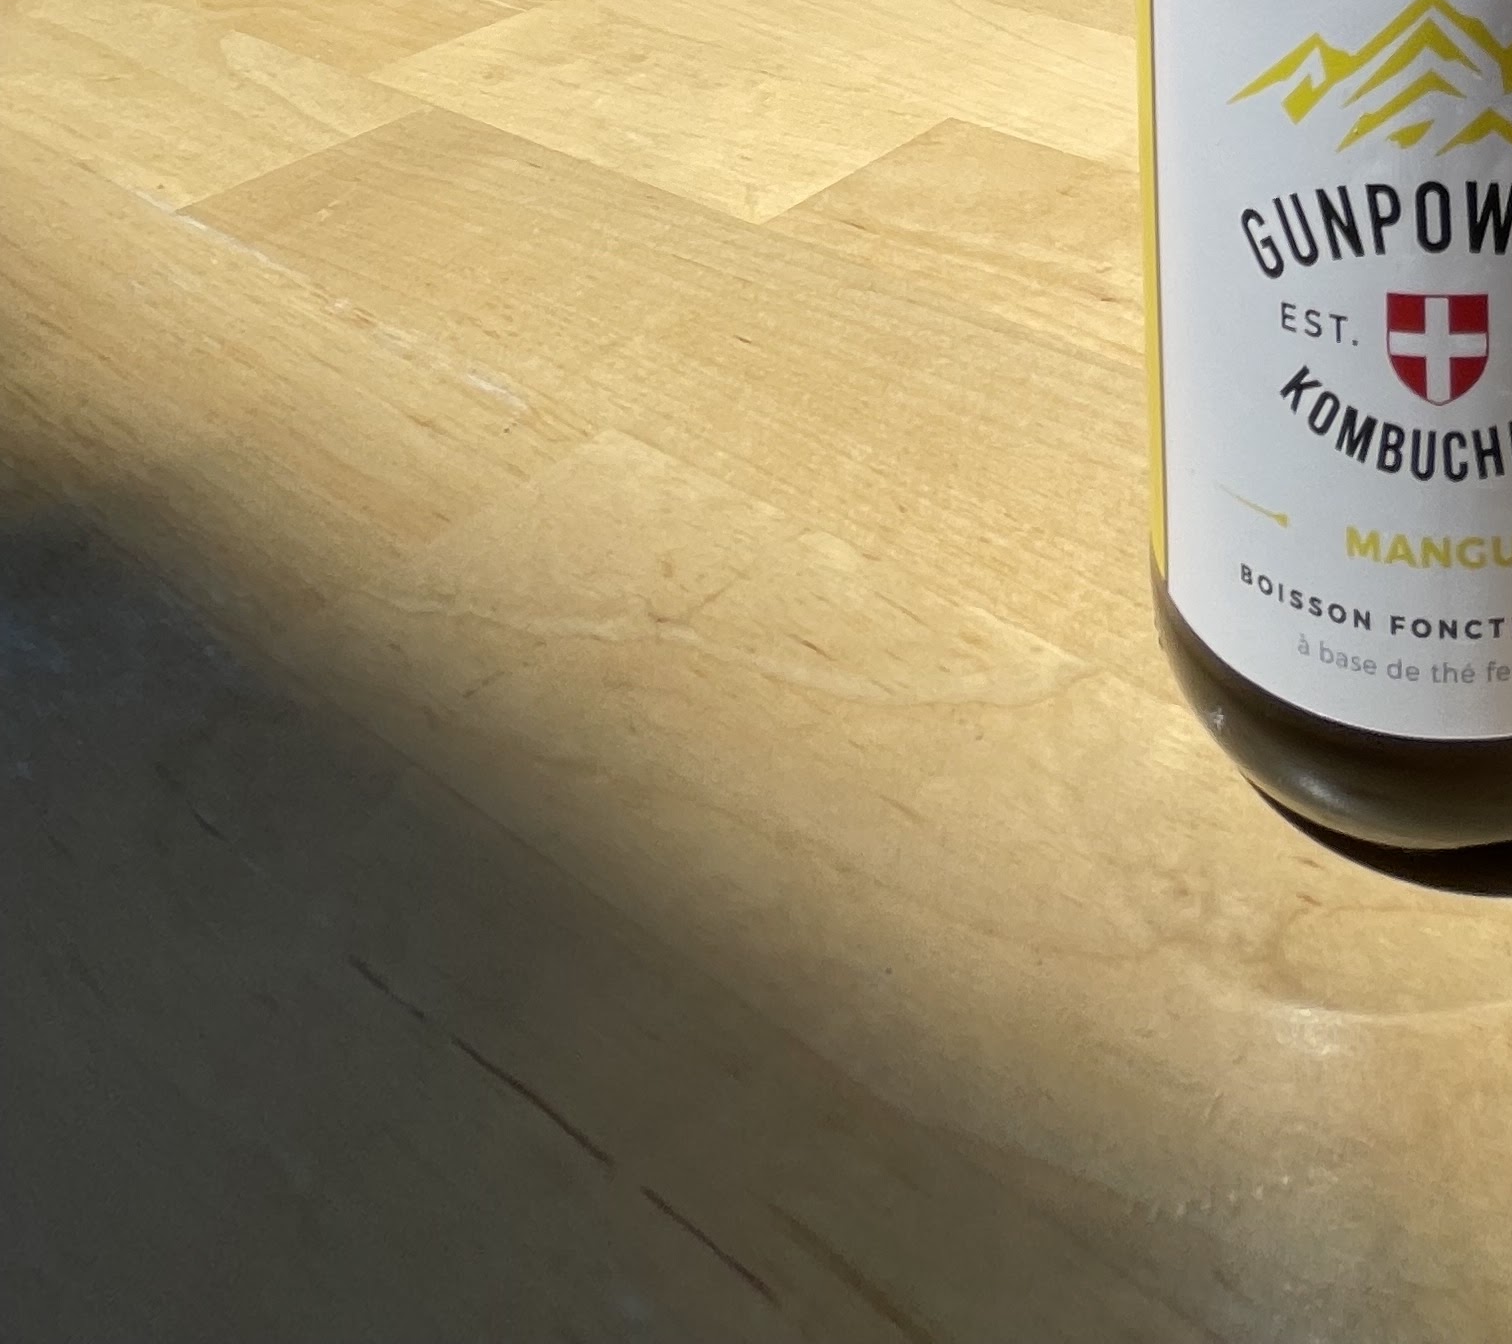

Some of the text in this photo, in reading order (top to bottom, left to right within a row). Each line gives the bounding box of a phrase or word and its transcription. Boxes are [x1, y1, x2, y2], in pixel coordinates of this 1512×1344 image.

[1280, 301, 1359, 347] EST.
[1240, 562, 1372, 631] BOISSON
[1297, 632, 1310, 657] à
[1318, 640, 1378, 676] base
[1386, 658, 1421, 682] de
[1431, 661, 1476, 685] thé
